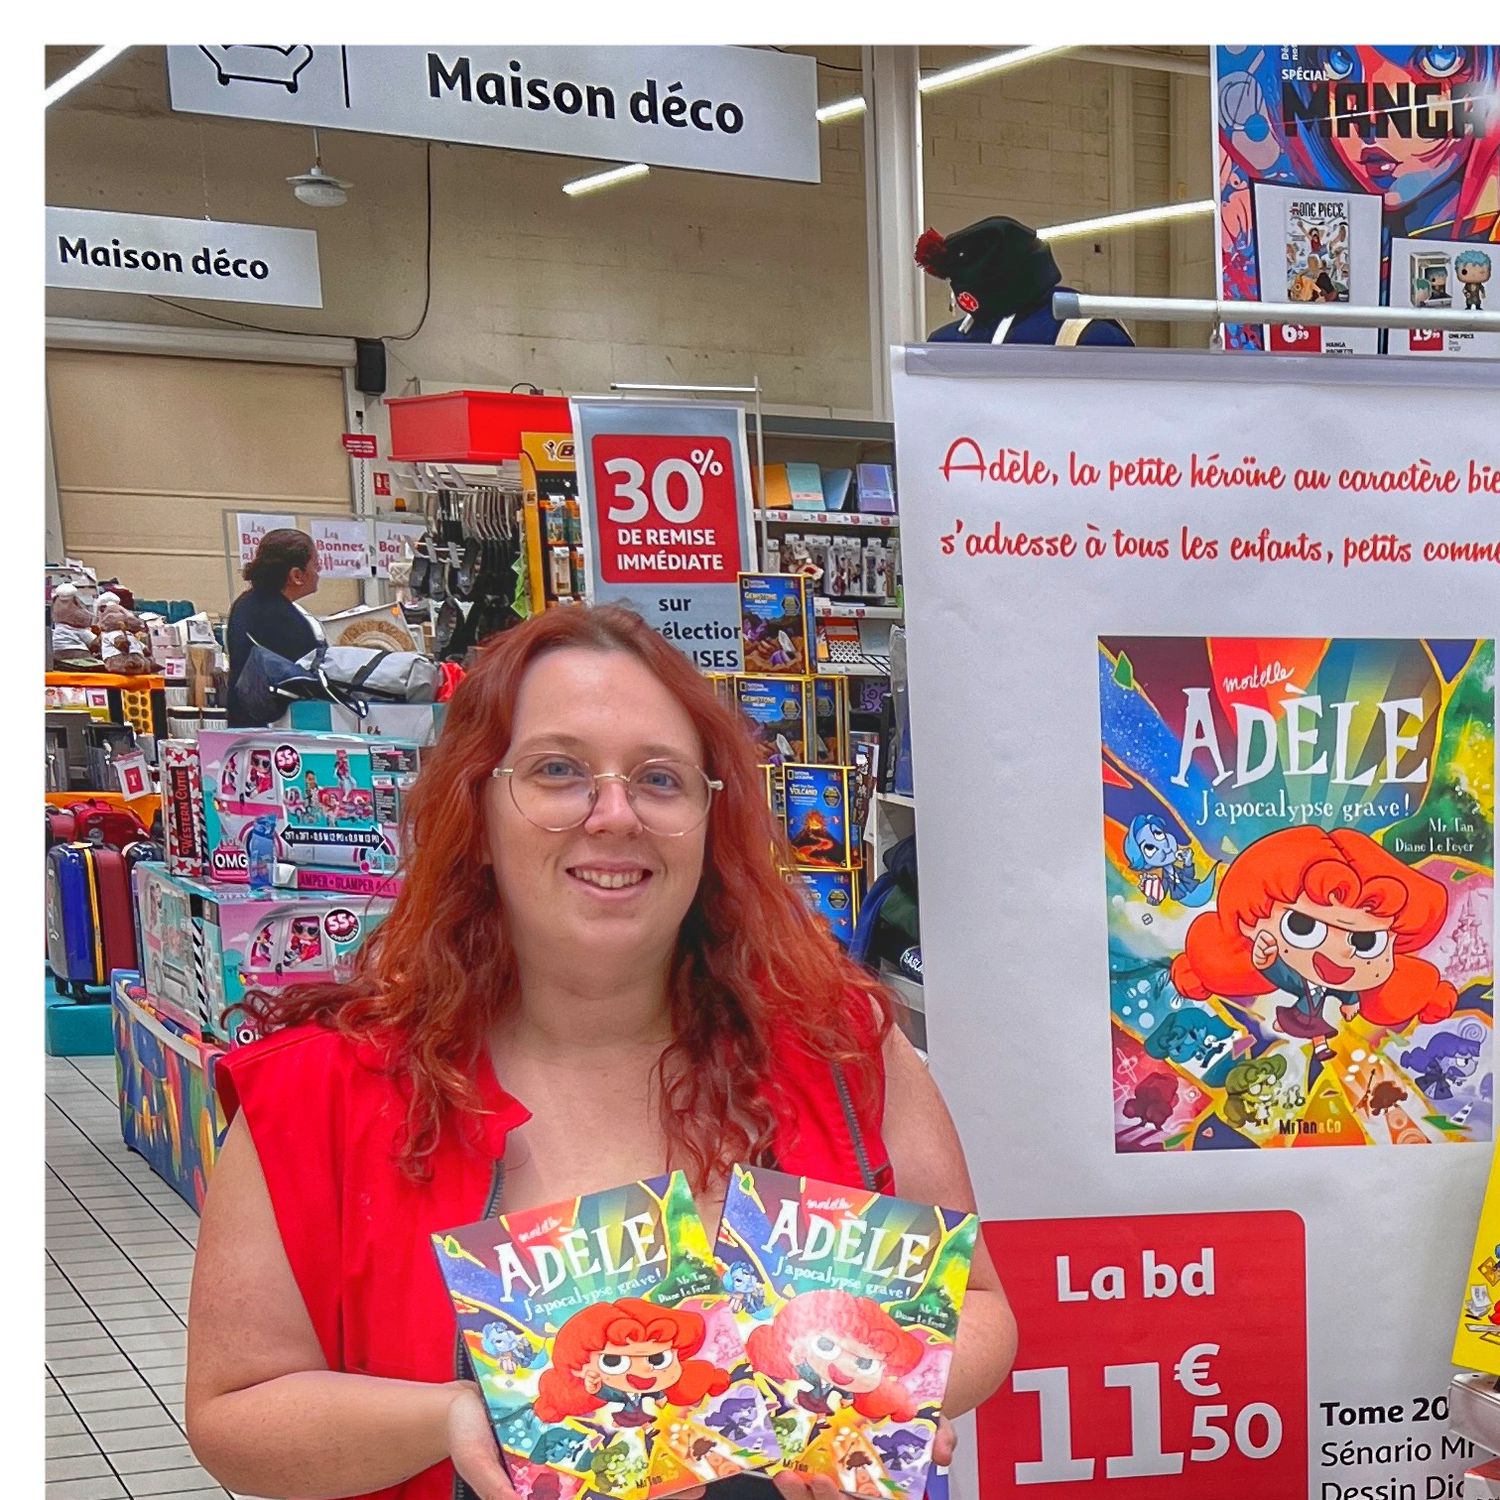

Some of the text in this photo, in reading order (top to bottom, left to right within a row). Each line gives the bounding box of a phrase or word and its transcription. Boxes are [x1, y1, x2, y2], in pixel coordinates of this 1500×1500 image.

[1281, 66, 1329, 82] SPÉCIAL
[427, 52, 745, 135] Maison déco
[1283, 82, 1487, 138] MANGA
[58, 236, 269, 281] Maison déco
[939, 436, 1060, 487] Adèle,
[1070, 451, 1101, 484] la
[1108, 456, 1182, 491] petite
[1190, 454, 1287, 490] héroïne
[1294, 468, 1330, 493] au
[1338, 458, 1461, 494] caractère
[316, 540, 365, 552] Bonnes
[618, 529, 716, 546] DE REMISE
[941, 519, 1077, 558] s'adresse
[1085, 524, 1107, 558] à
[1113, 529, 1170, 559] tous
[1180, 525, 1219, 561] les
[1230, 527, 1335, 564] enfants,
[1344, 531, 1412, 565] petits
[617, 552, 723, 570] IMMÉDIATE
[659, 598, 691, 612] sur
[1169, 682, 1429, 789] ADÈLE
[789, 788, 818, 796] VOLCANO
[1197, 788, 1334, 826] J'apocalypse
[181, 801, 193, 855] WESTERN
[1429, 818, 1474, 833] Mr Tan
[214, 852, 248, 869] OMG
[1395, 838, 1474, 855] Diane Le Feyer
[494, 1212, 668, 1303] ADÈLE
[760, 1198, 931, 1284] ADÈLE
[1056, 1247, 1216, 1303] La bd
[1320, 1396, 1449, 1428] Tome 20
[1321, 1436, 1432, 1468] Sénario
